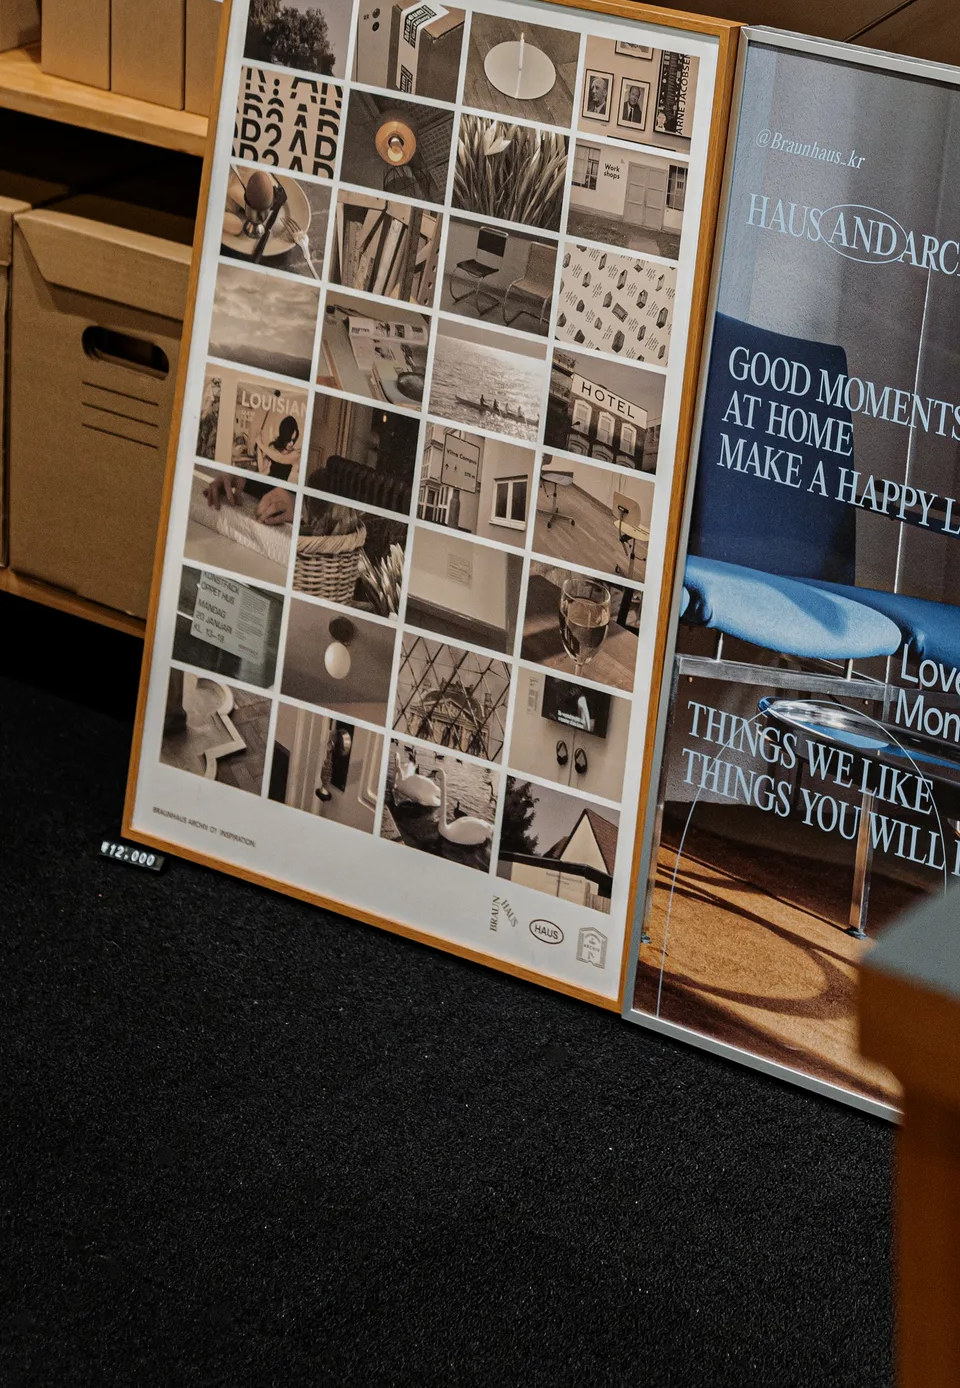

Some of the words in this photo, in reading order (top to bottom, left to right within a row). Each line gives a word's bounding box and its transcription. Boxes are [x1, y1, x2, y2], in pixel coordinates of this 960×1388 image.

[676, 109, 685, 136] ARNE
[604, 162, 620, 173] Work
[755, 128, 866, 170] @Braunhaus_kr
[603, 170, 621, 181] shops
[746, 193, 823, 242] HAUS
[829, 213, 898, 258] AND
[728, 345, 812, 397] GOOD
[581, 381, 635, 420] HOTEL
[721, 390, 763, 429] AT
[766, 399, 855, 458] HOME
[459, 453, 477, 465] Campus
[716, 433, 803, 489] MAKE
[806, 463, 831, 498] A
[834, 469, 938, 528] HAPPY
[687, 700, 798, 770] THINGS
[805, 739, 853, 789] WE
[859, 756, 935, 815] LIKE
[152, 806, 188, 824] BRAUNHAUS
[188, 818, 209, 831] ARCHIV
[682, 747, 793, 818] THINGS
[800, 789, 862, 843] YOU
[867, 815, 947, 870] WILL
[489, 894, 501, 933] BRAUN
[501, 899, 519, 928] HAUS
[534, 923, 560, 940] HAUS
